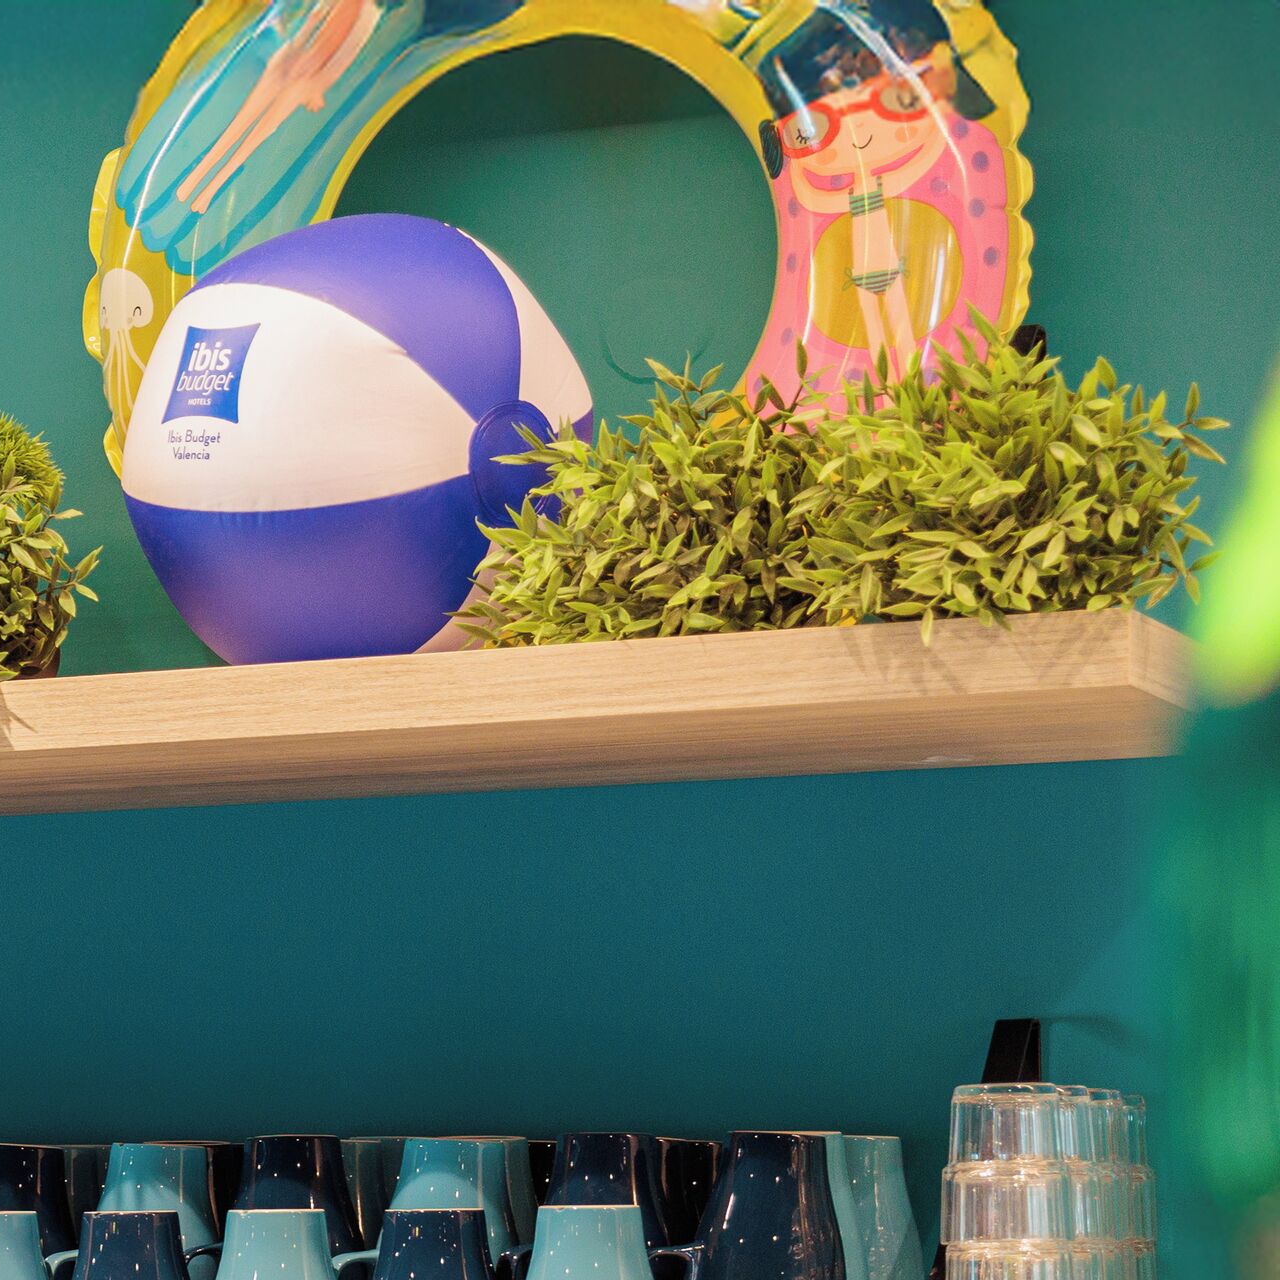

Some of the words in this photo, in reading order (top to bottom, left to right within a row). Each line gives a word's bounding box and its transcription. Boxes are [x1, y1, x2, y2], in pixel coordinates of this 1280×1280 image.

[188, 342, 231, 371] ibis
[176, 370, 234, 395] budget
[168, 430, 182, 443] Ibis
[185, 429, 221, 446] Budget
[173, 446, 210, 460] Valencia
